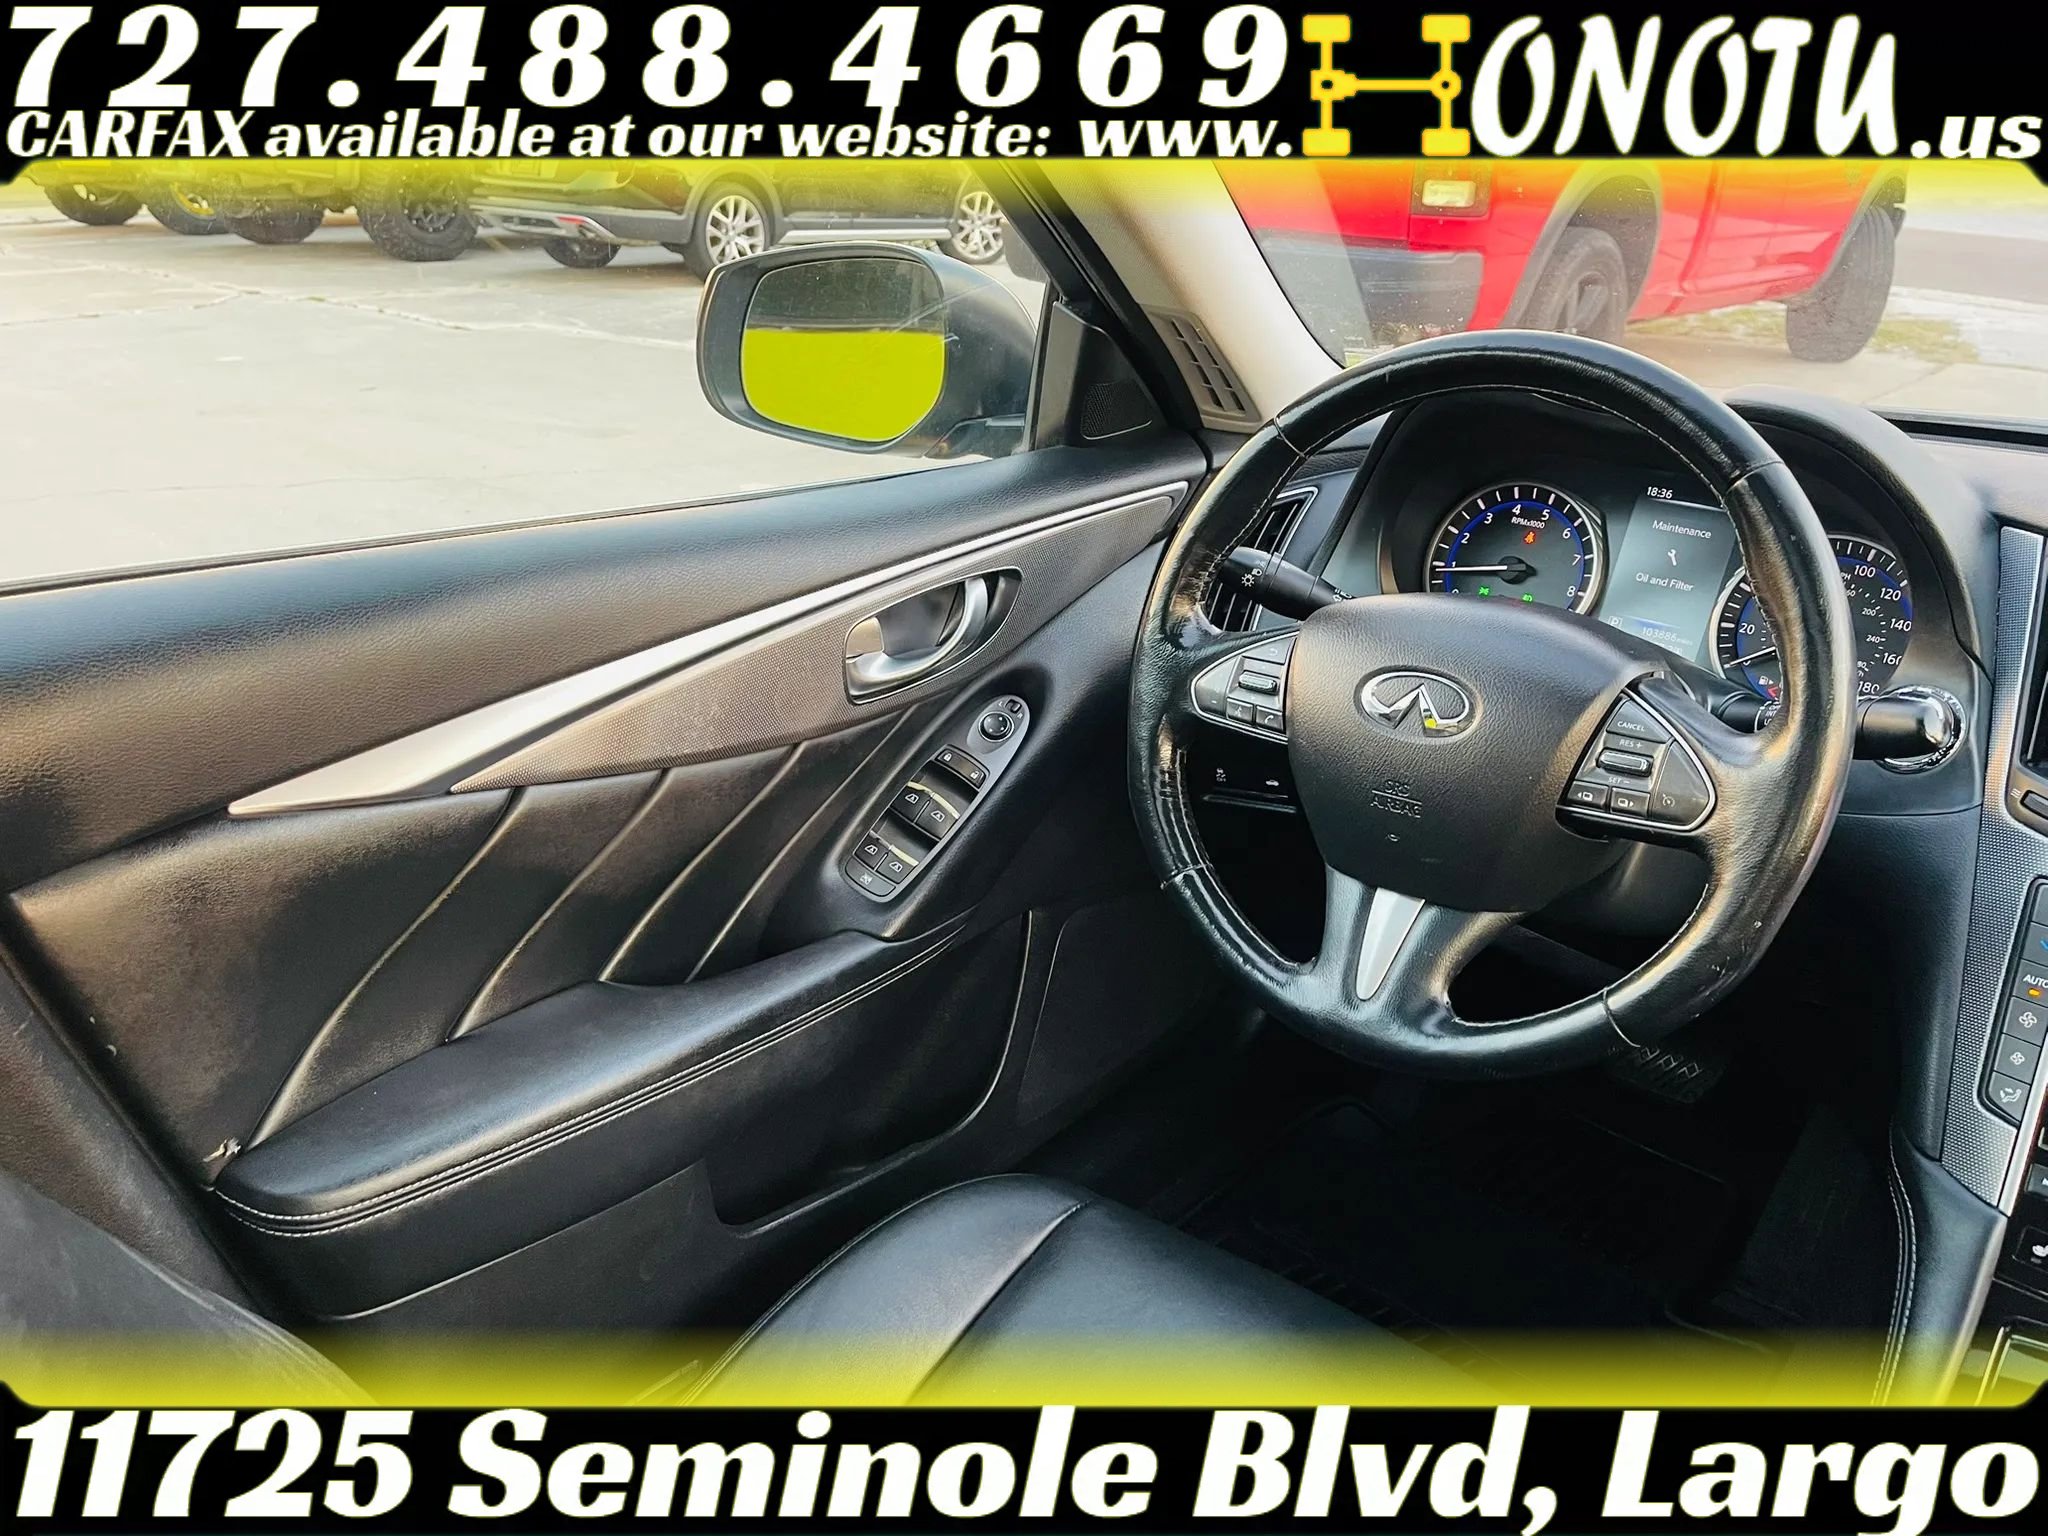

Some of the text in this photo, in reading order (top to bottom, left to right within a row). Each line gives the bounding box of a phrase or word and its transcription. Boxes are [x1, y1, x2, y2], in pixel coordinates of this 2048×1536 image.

[1647, 486, 1673, 499] 18:36
[1511, 504, 1521, 516] 4
[1541, 508, 1551, 521] 5
[1484, 512, 1493, 524] 3
[1511, 516, 1545, 529] RPMx1000
[1562, 527, 1571, 539] 6
[1652, 519, 1712, 539] Maintenance
[1461, 532, 1470, 544] 2
[1571, 554, 1581, 565] 7
[1854, 565, 1876, 578] 100
[1635, 572, 1694, 592] Oil and Filter
[1566, 585, 1576, 597] 8
[1880, 587, 1901, 601] 120
[1861, 607, 1877, 617] 200
[1738, 622, 1756, 635] 20
[1890, 618, 1912, 632] 140
[1866, 634, 1880, 643] 240
[1617, 720, 1645, 732] CANCEL
[1619, 738, 1634, 748] RES
[1608, 776, 1622, 785] SET
